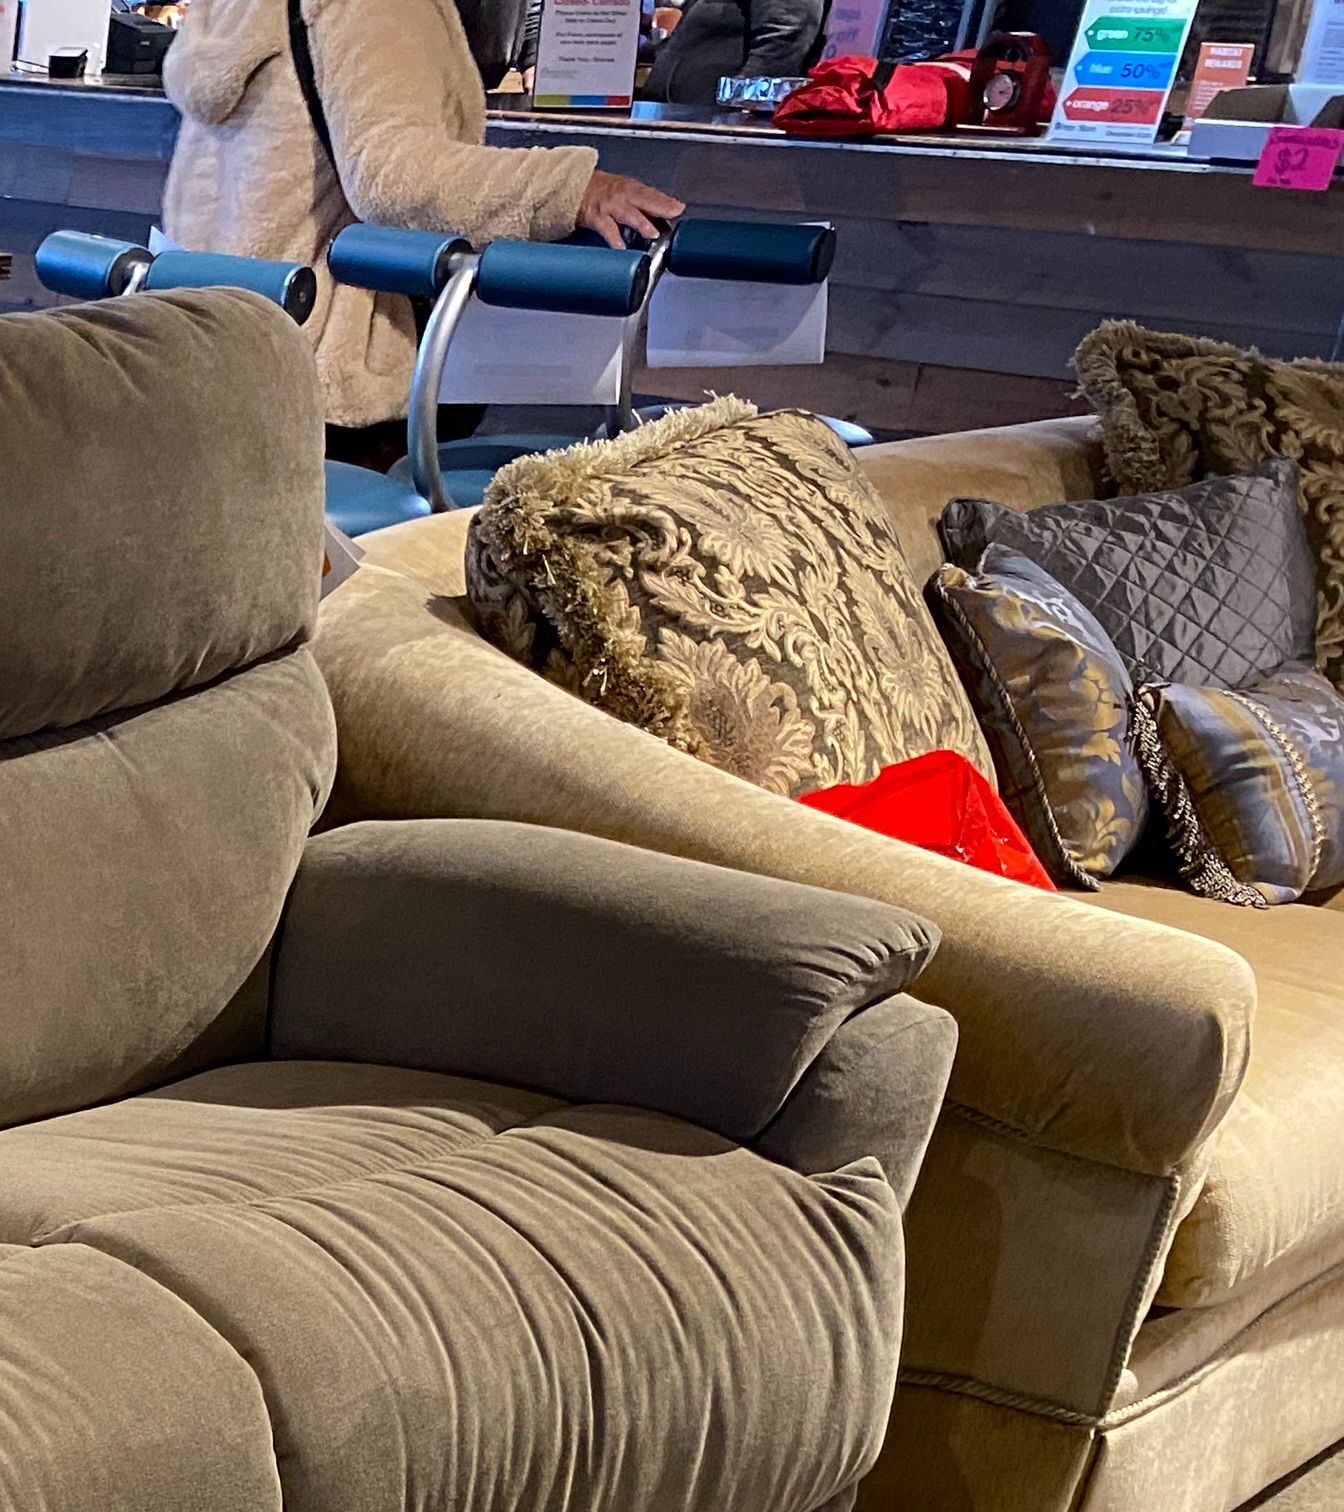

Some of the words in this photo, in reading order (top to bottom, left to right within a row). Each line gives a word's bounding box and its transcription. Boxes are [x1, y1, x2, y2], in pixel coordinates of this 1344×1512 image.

[1096, 29, 1129, 41] green
[1133, 26, 1171, 42] 75%
[1089, 63, 1112, 74] blue
[1120, 63, 1162, 79] 50%
[1072, 100, 1110, 112] orange
[1111, 99, 1150, 115] 25%
